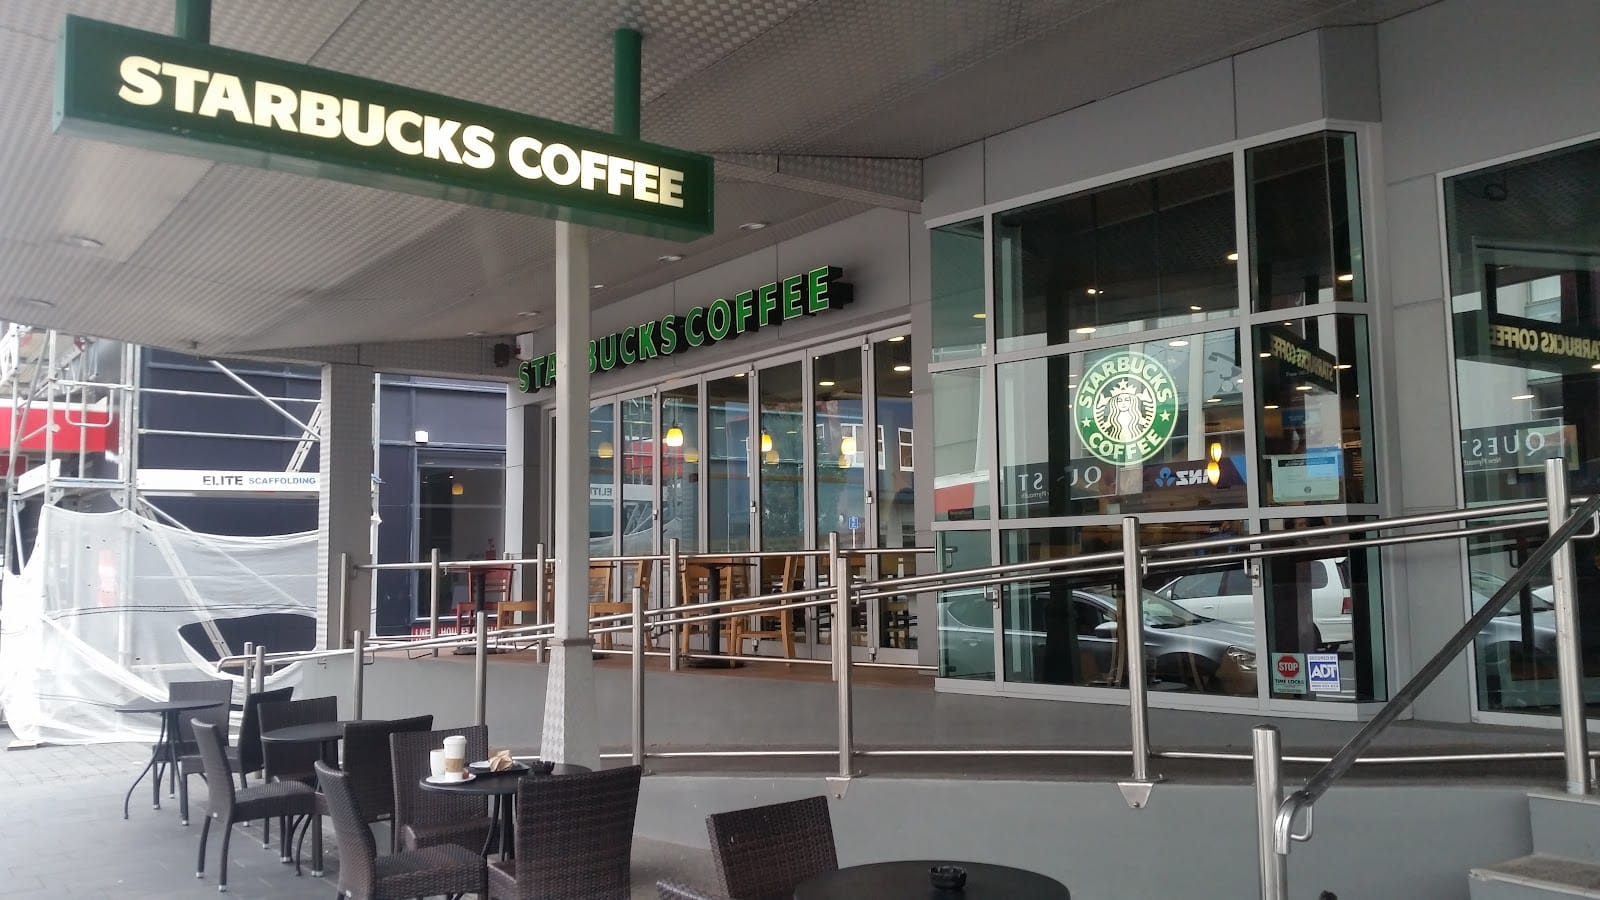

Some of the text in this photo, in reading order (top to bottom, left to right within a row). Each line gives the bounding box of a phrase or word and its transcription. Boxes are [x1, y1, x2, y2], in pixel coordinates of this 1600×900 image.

[118, 55, 685, 209] STARBUCKS COFFEE
[518, 264, 830, 393] STABUCKS COFFEE
[1079, 356, 1173, 409] STARBUCKS
[1088, 428, 1162, 460] COFFEE
[203, 475, 317, 486] ELITE SCAFFOLDING
[1279, 662, 1299, 672] STOP
[1312, 664, 1337, 678] ADT
